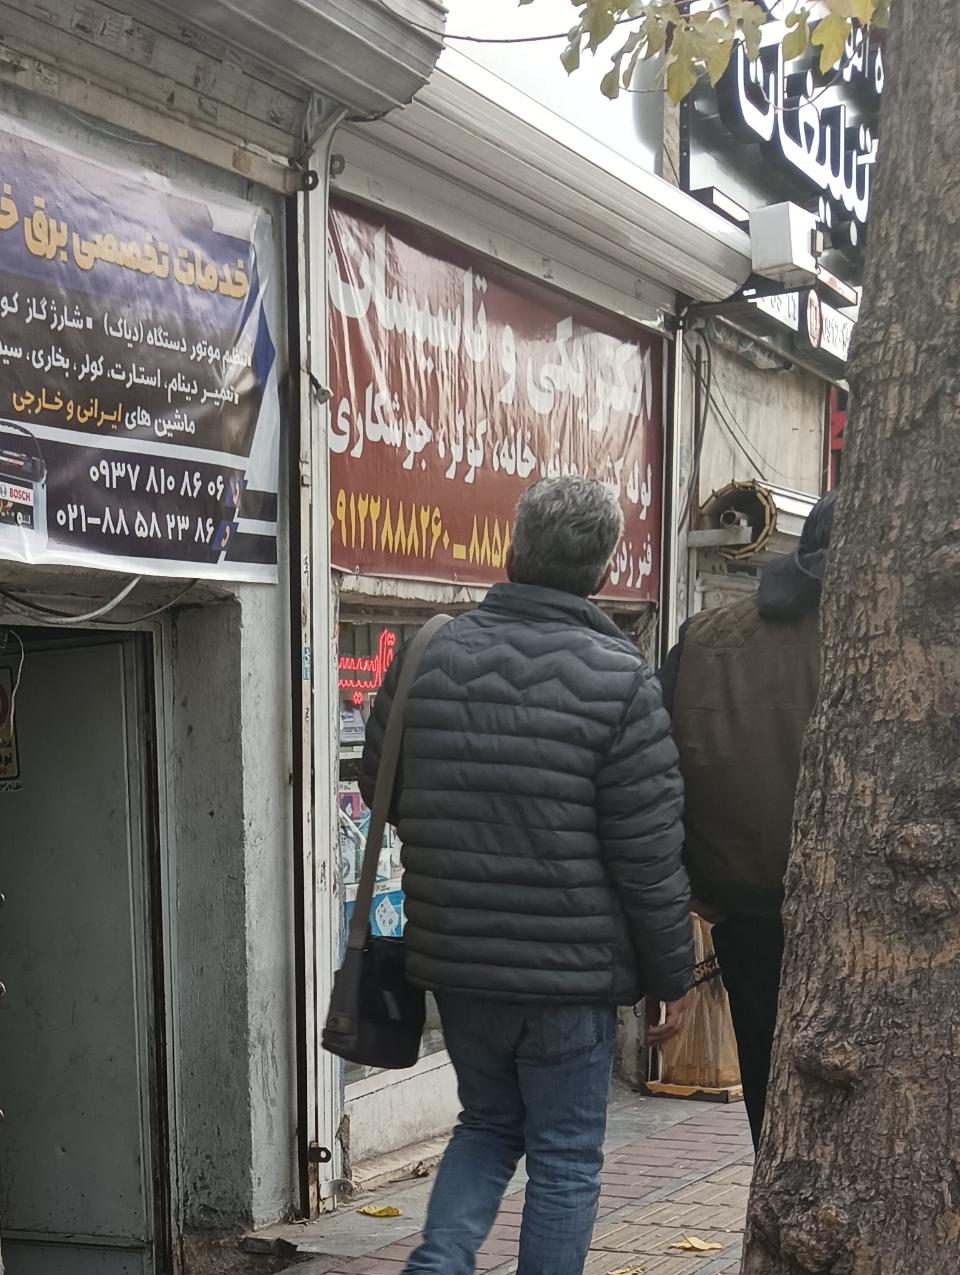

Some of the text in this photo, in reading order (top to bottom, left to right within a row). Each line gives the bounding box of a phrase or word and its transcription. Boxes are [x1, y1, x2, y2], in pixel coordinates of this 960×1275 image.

[23, 196, 69, 262] برق
[71, 230, 170, 279] تخصصی
[174, 247, 250, 299] خدمات
[25, 297, 48, 324] گاز
[50, 300, 84, 331] شارژ
[146, 326, 187, 352] دستگاه
[189, 339, 221, 364] موتور
[495, 323, 518, 405] و
[12, 388, 196, 438] ماشین های ایرانی و خارجی
[328, 382, 433, 470] جوشکاری
[9, 487, 31, 502] BOSCH
[89, 459, 225, 502] ۰۹۳۷ ۸۱۰ ۸۶ ۰۶
[134, 509, 162, 539] ۵۸
[166, 514, 190, 541] ۲۳
[194, 516, 215, 544] ۸۶
